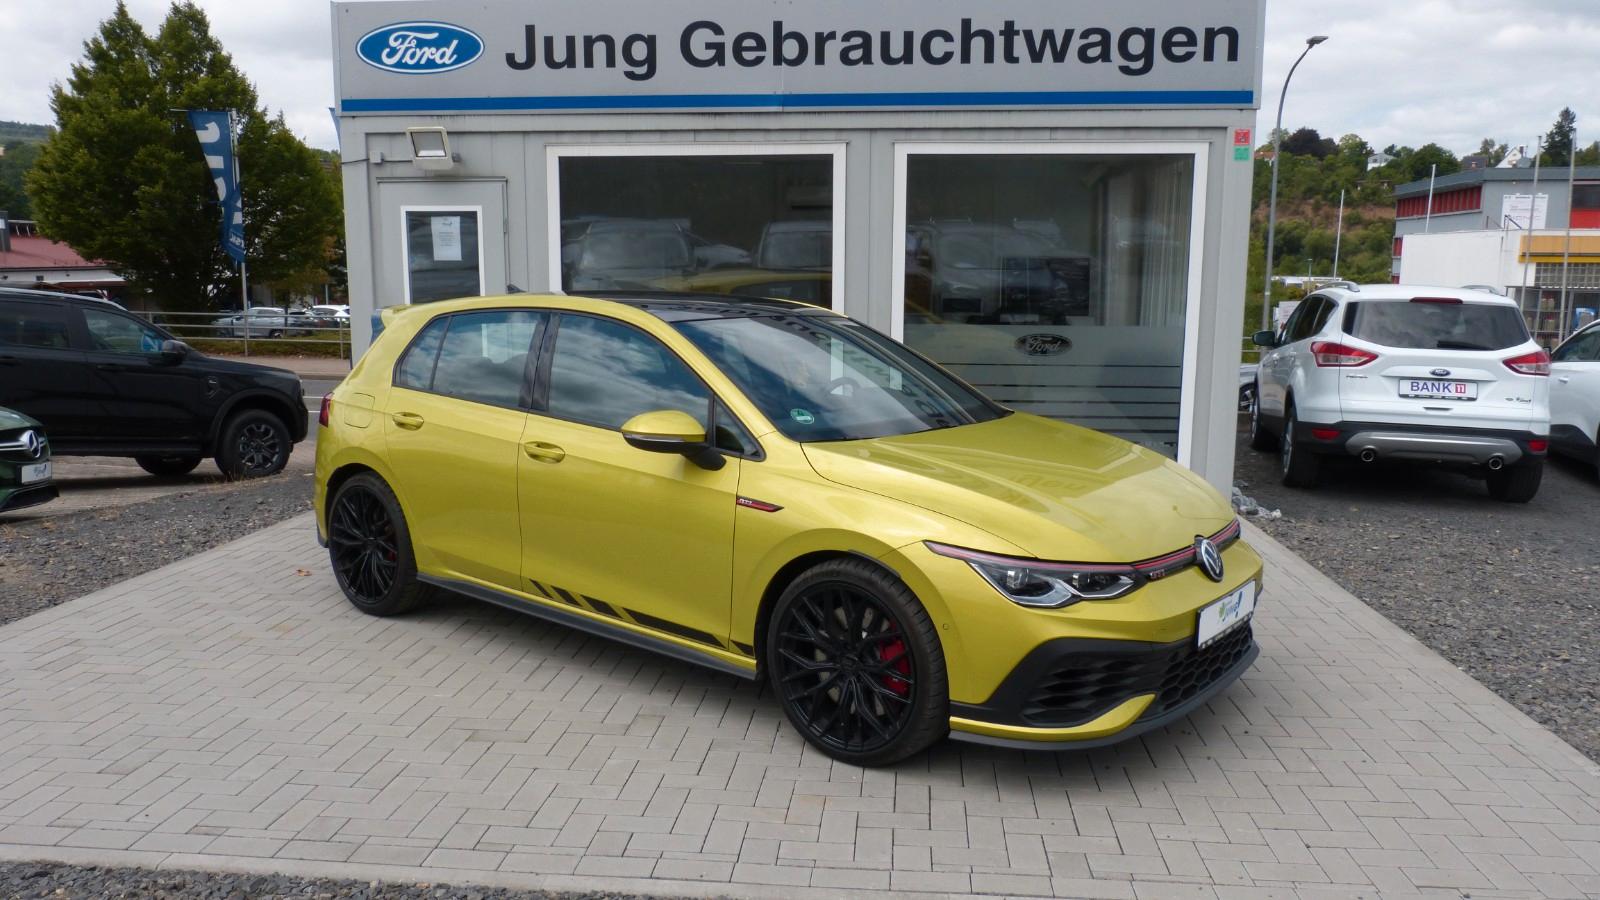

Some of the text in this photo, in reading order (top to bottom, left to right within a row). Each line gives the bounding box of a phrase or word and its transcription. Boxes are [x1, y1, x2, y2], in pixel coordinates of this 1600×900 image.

[381, 31, 460, 65] Ford
[506, 18, 1238, 81] Jung Gebrauchtwagen
[1410, 381, 1452, 393] BANK
